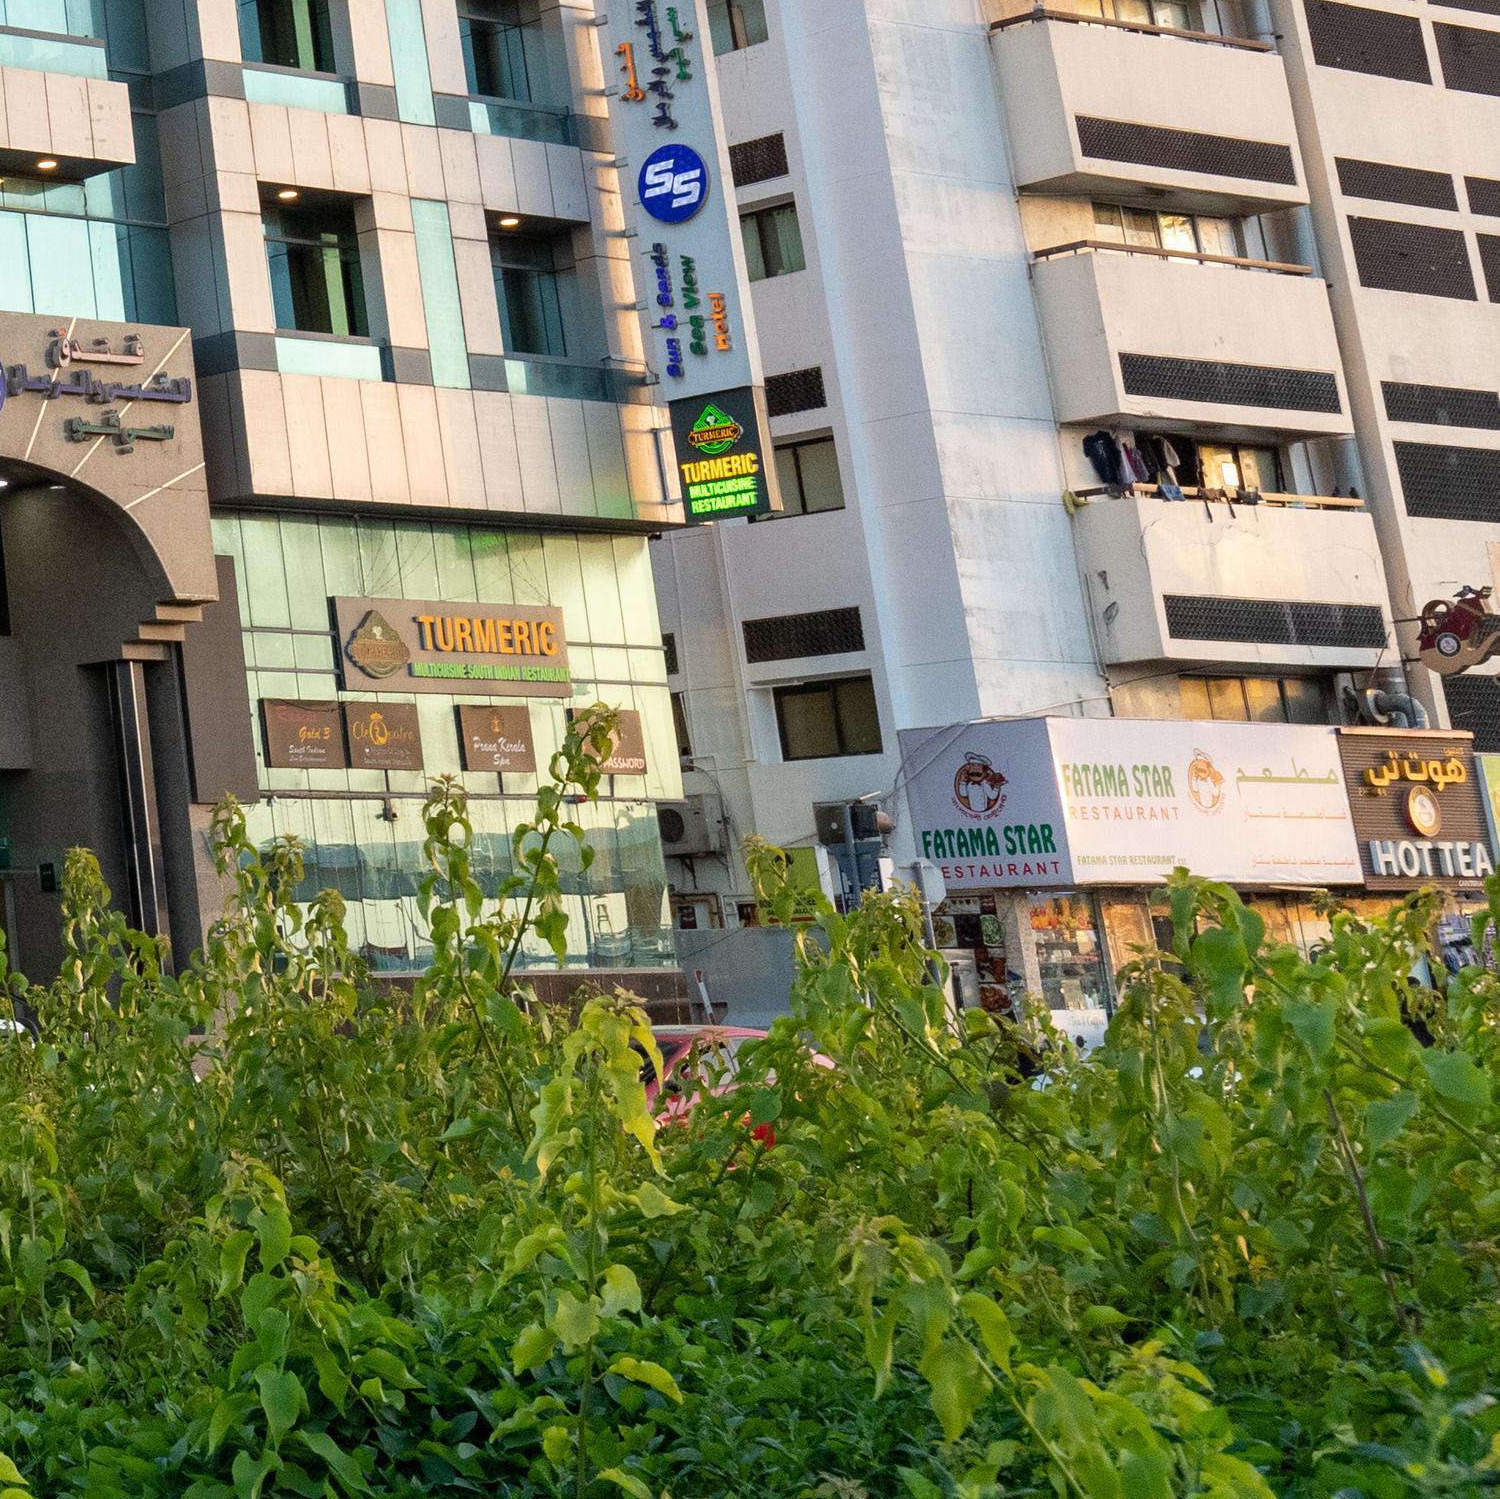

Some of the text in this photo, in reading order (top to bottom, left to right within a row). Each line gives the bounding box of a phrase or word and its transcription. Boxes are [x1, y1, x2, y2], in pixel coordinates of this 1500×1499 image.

[614, 42, 646, 102] فندق
[645, 159, 700, 208] SS
[651, 242, 684, 378] Sun & Sands
[680, 254, 707, 356] Sea View
[707, 292, 731, 351] Hotel
[56, 327, 145, 369] فندق
[694, 428, 734, 441] TURMERIC
[681, 452, 757, 484] TURMERIC
[689, 477, 757, 499] MULTICUISINE
[691, 492, 758, 514] RESTAURANT
[416, 615, 558, 656] TURMERIC
[522, 666, 570, 683] RESTAURANT
[323, 726, 330, 740] 3
[499, 737, 526, 753] Kerala
[493, 754, 510, 766] Spa
[1235, 755, 1339, 799] مطعم
[1404, 751, 1468, 792] هوت
[1062, 763, 1176, 798] FATAMA STAR
[1068, 805, 1181, 822] RESTAURANT
[921, 823, 1057, 859] FATAMA STAR
[1372, 840, 1434, 877] HOT
[1437, 841, 1495, 877] TEA
[942, 861, 1060, 879] ESTAURANT
[1077, 855, 1107, 866] FATAMA
[1109, 855, 1128, 866] STAR
[1129, 855, 1177, 866] RESTAURANT
